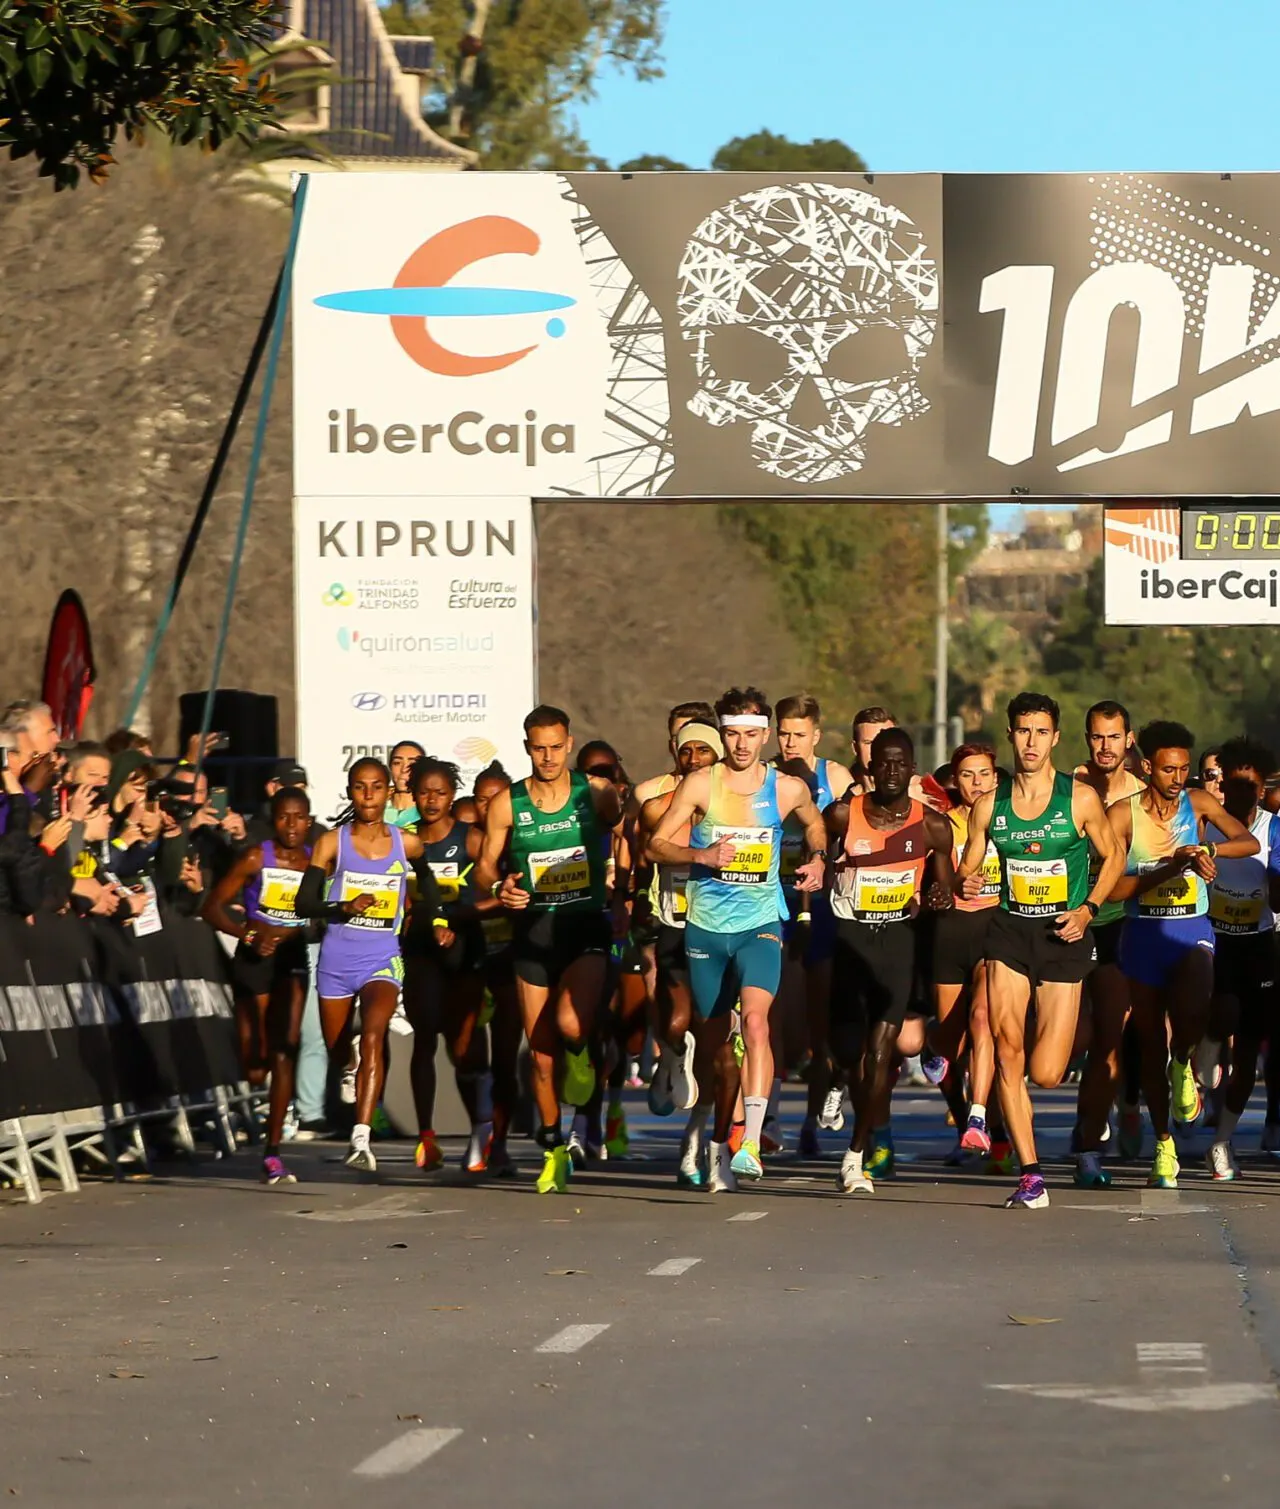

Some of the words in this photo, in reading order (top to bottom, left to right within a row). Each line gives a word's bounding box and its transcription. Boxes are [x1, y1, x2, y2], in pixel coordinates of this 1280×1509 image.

[327, 409, 576, 467] iberCaja
[318, 519, 516, 557] KIPRUN
[449, 579, 503, 593] Cultura
[357, 588, 419, 598] TRINIDAD
[357, 599, 419, 609] ALFONSO
[448, 594, 517, 609] Esfuerzo
[393, 694, 486, 708] HYUNDAI
[394, 712, 443, 723] Autiber
[446, 712, 487, 723] Motor
[721, 872, 760, 882] KIPRUN
[859, 875, 894, 884] iberCaja
[544, 890, 581, 902] KIPRUN
[1028, 885, 1051, 896] RUIZ
[871, 893, 906, 904] LOBALU
[1019, 904, 1057, 914] KIPRUN
[1149, 906, 1187, 915] KIPRUN
[865, 910, 903, 920] KIPRUN
[1215, 920, 1249, 932] KIPRUN
